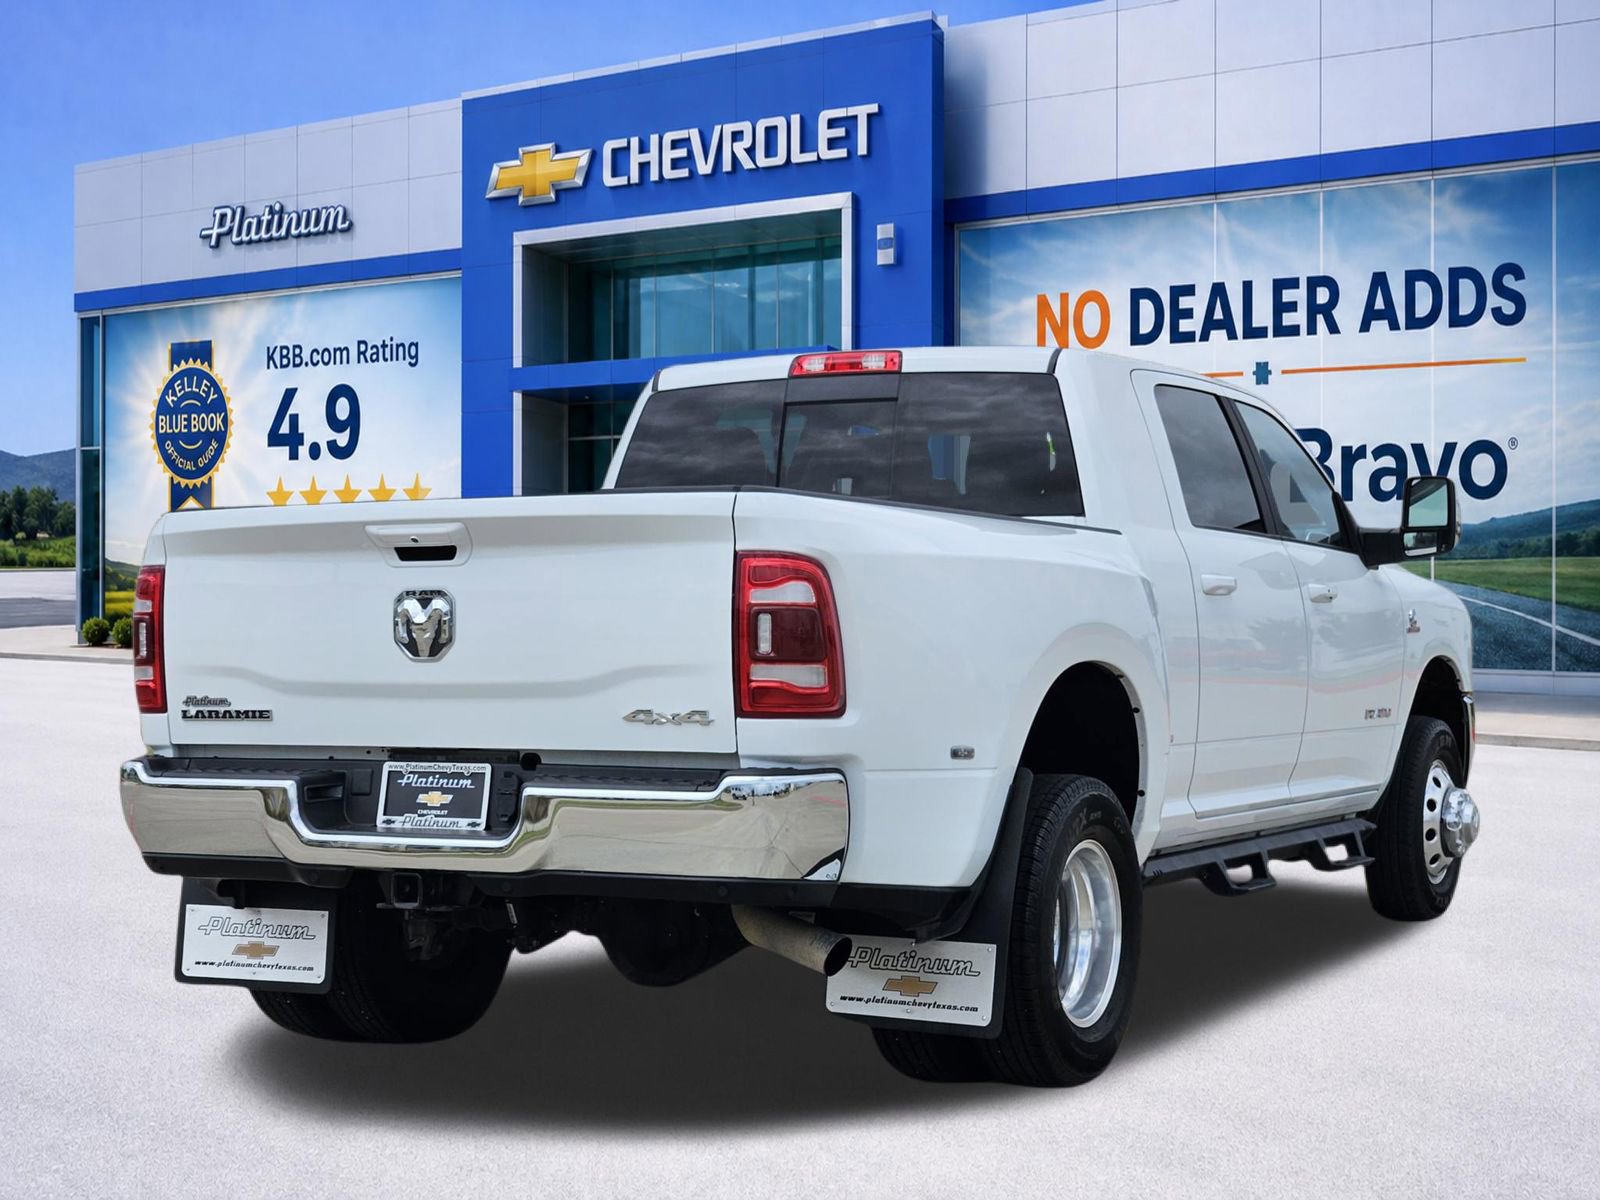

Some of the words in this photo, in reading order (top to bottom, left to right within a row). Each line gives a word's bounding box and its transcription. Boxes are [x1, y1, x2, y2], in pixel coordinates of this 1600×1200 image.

[602, 102, 879, 187] CHEVROLET
[200, 201, 354, 248] Platinum
[1036, 289, 1111, 349] NO
[1129, 274, 1341, 347] DEALER
[1358, 262, 1527, 334] ADDS
[266, 343, 350, 370] KBB.com
[356, 336, 419, 368] Rating
[165, 375, 218, 408] KELLEY
[158, 414, 188, 433] BLUE
[191, 412, 225, 433] BOOK
[267, 383, 361, 461] 4.9
[164, 440, 196, 470] OFFICIAL
[197, 438, 219, 468] GUIDE
[181, 709, 273, 721] LARAMIE
[397, 774, 476, 789] Platinum
[399, 815, 464, 828] Platinum
[198, 916, 316, 940] Platinum
[194, 960, 315, 972] www.platinumchevytexas.com
[848, 946, 981, 977] Platinum
[839, 994, 979, 1013] www.platinumchevytexas.com
